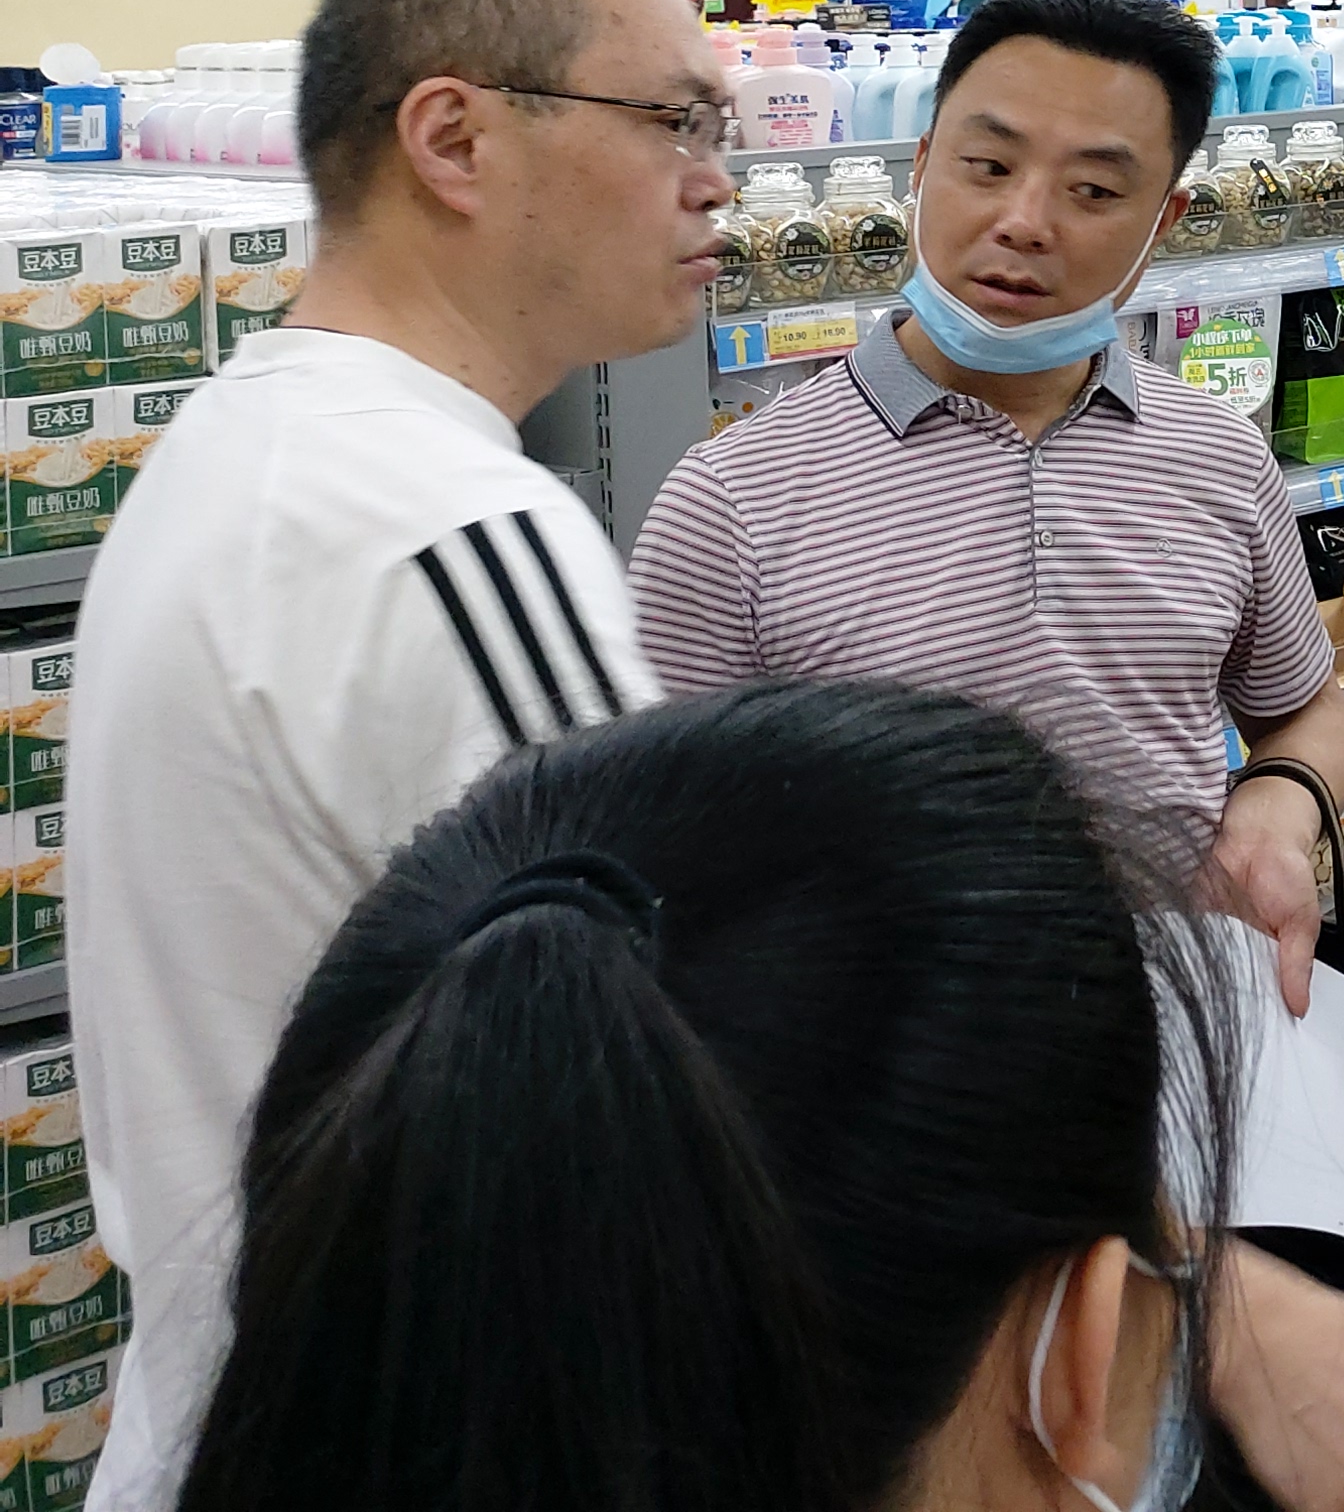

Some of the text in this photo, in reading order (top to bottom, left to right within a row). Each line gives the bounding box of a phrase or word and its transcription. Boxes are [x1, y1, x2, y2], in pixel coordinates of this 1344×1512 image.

[23, 247, 79, 273] 豆本豆
[126, 238, 180, 265] 豆本豆
[234, 231, 286, 258] 豆本豆
[1207, 363, 1248, 396] 5折
[32, 402, 91, 430] 豆本豆
[36, 655, 74, 685] 豆本
[31, 1058, 76, 1090] 豆本
[26, 1144, 85, 1182] 唯甄豆
[34, 1211, 92, 1250] 豆本豆
[47, 1368, 104, 1408] 豆本豆
